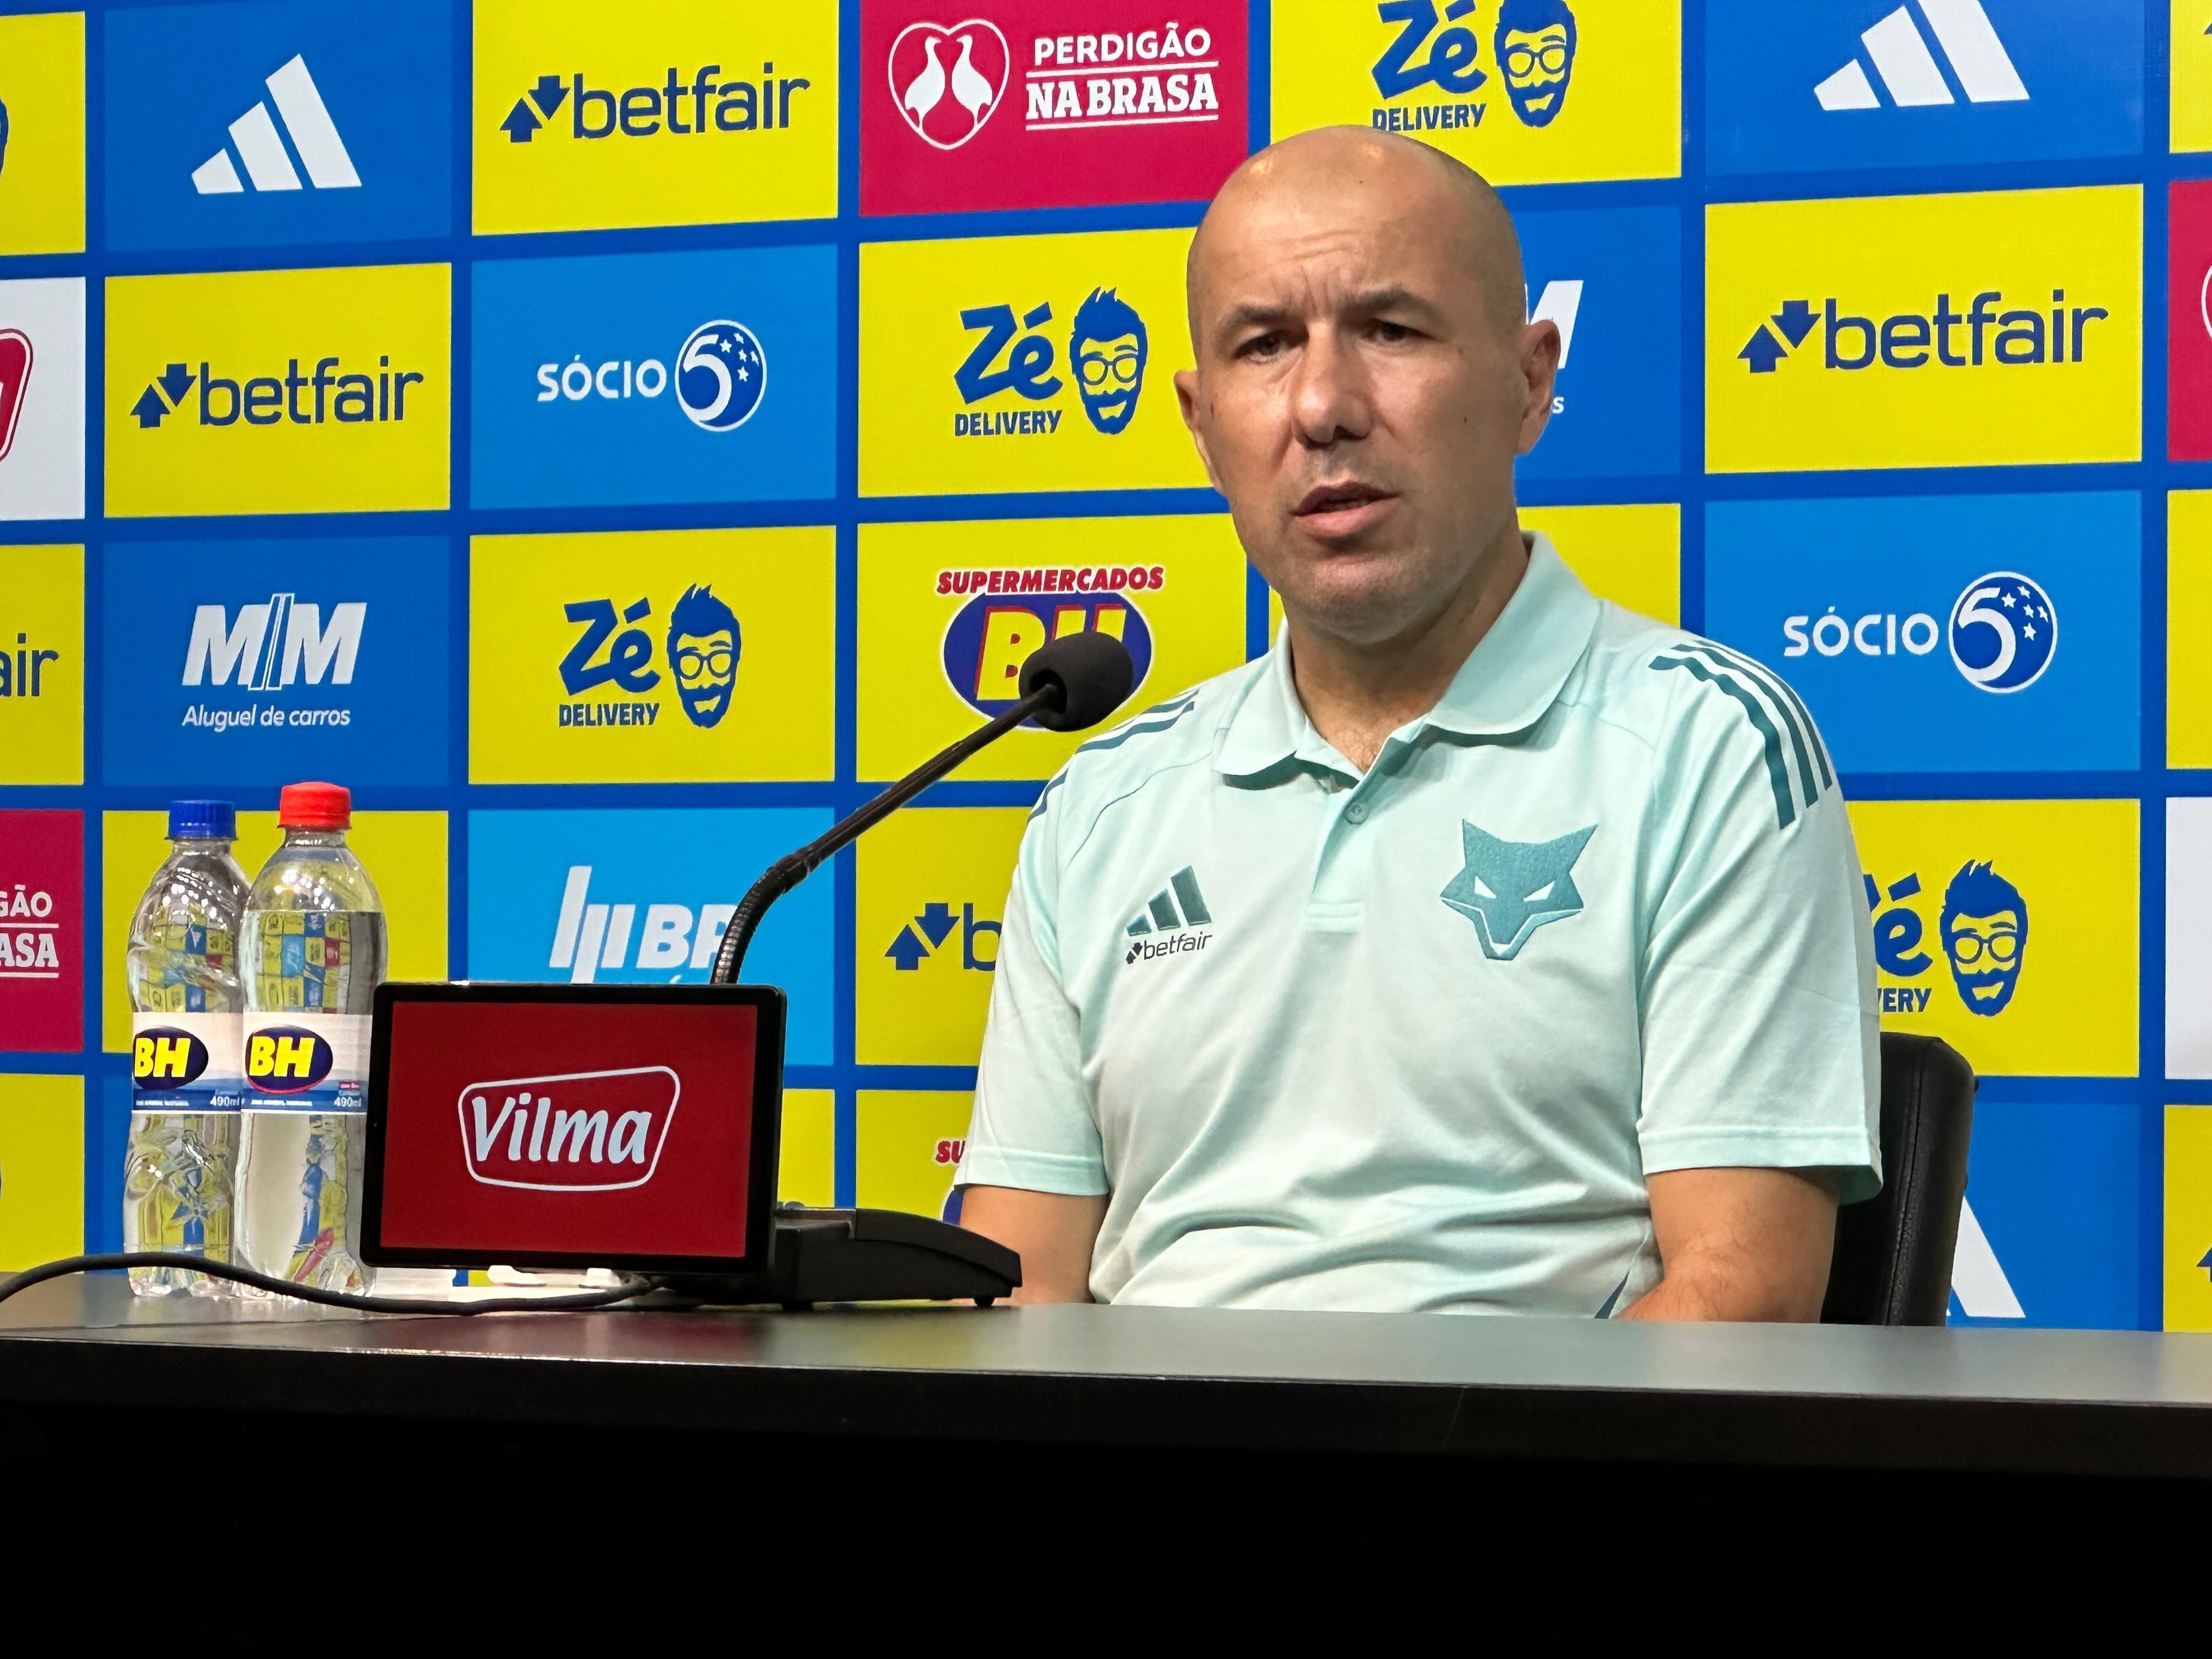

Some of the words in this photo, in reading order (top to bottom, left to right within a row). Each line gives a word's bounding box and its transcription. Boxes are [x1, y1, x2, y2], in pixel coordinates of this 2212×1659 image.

[1035, 21, 1211, 66] PERDIGÃO
[1372, 0, 1487, 100] Zé
[573, 62, 810, 139] betfair
[1025, 80, 1083, 120] NA
[1086, 72, 1218, 116] BRASA
[1373, 103, 1486, 132] DELIVERY
[953, 302, 1063, 405] Zé
[1825, 289, 2109, 370] betfair
[200, 355, 424, 426] betfair
[537, 354, 667, 402] SÓCIO
[955, 410, 1063, 437] DELIVERY
[936, 566, 1164, 595] SUPERMERCADOS
[558, 597, 662, 696] Zé
[974, 604, 1127, 701] B
[1784, 606, 1939, 657] SÓCIO
[182, 704, 257, 732] Aluguel
[260, 705, 285, 726] de
[289, 710, 351, 726] carros
[559, 703, 660, 727] DELIVERY
[1144, 931, 1212, 960] betfair
[134, 1037, 190, 1077] BH
[249, 1036, 315, 1077] BH
[471, 1092, 653, 1164] Vilma
